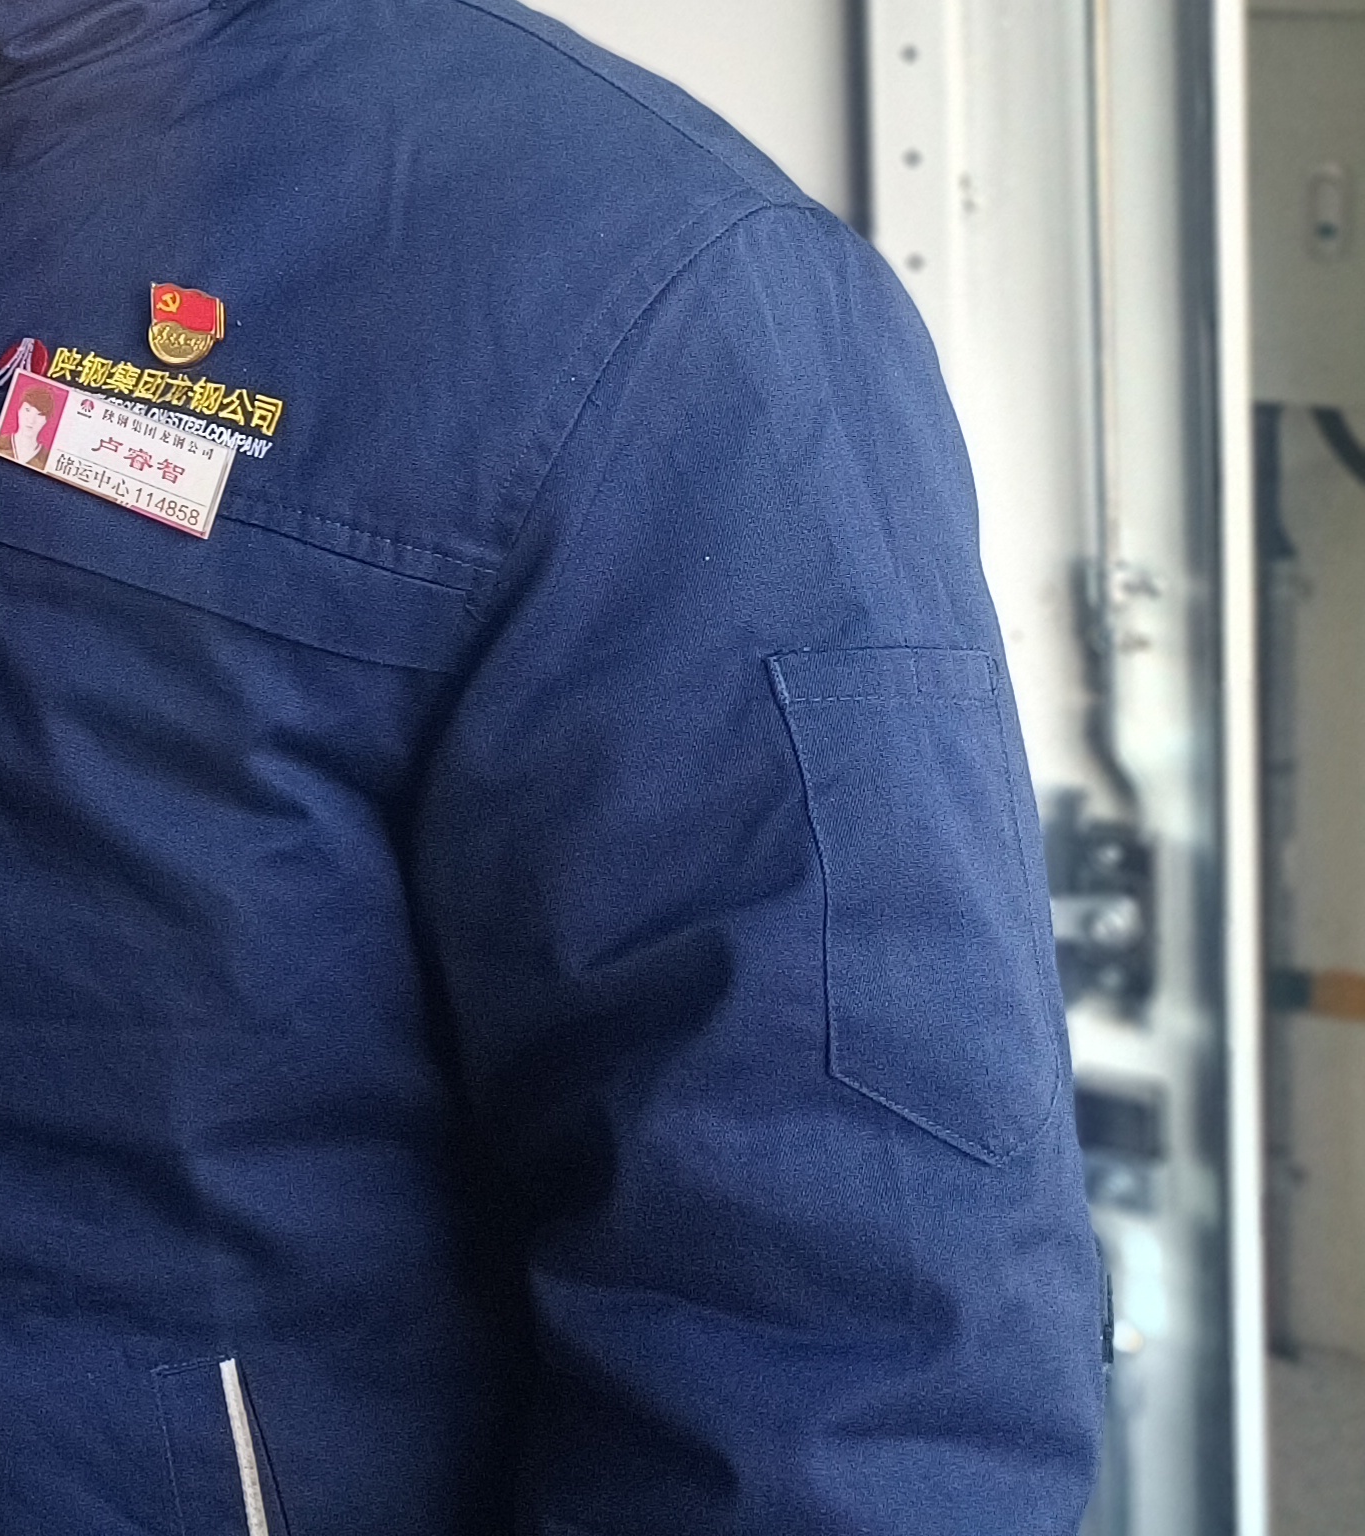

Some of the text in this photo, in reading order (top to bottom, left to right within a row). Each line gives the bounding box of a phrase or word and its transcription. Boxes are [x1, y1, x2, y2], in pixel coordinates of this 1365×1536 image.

[47, 346, 284, 437] 陕钢集团龙钢公司
[91, 436, 186, 485] 卢睿智
[101, 408, 214, 461] 陕钢集团龙钢公司
